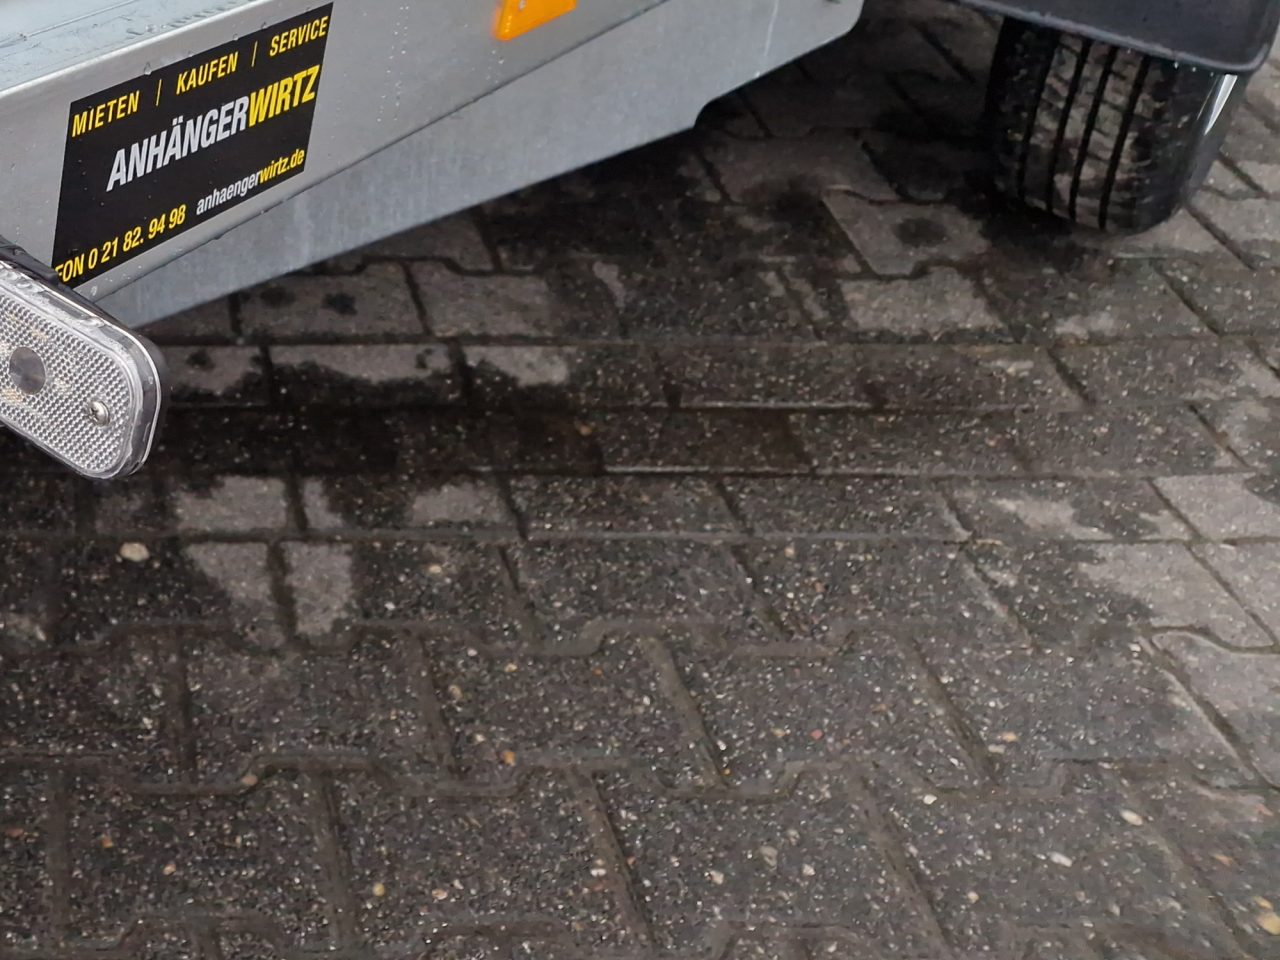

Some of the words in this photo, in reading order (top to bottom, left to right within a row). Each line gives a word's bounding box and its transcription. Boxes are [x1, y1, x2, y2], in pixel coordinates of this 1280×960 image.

[71, 90, 139, 138] MIETEN
[176, 51, 239, 95] KAUFEN
[269, 15, 329, 57] SERVICE
[106, 64, 321, 192] ANHÄNGERWIRTZ
[88, 247, 98, 270] 0
[101, 236, 119, 263] 21
[122, 226, 144, 252] 82.
[148, 214, 166, 239] 94
[168, 203, 187, 229] 98
[196, 148, 305, 215] anhaengerwirtz.de
